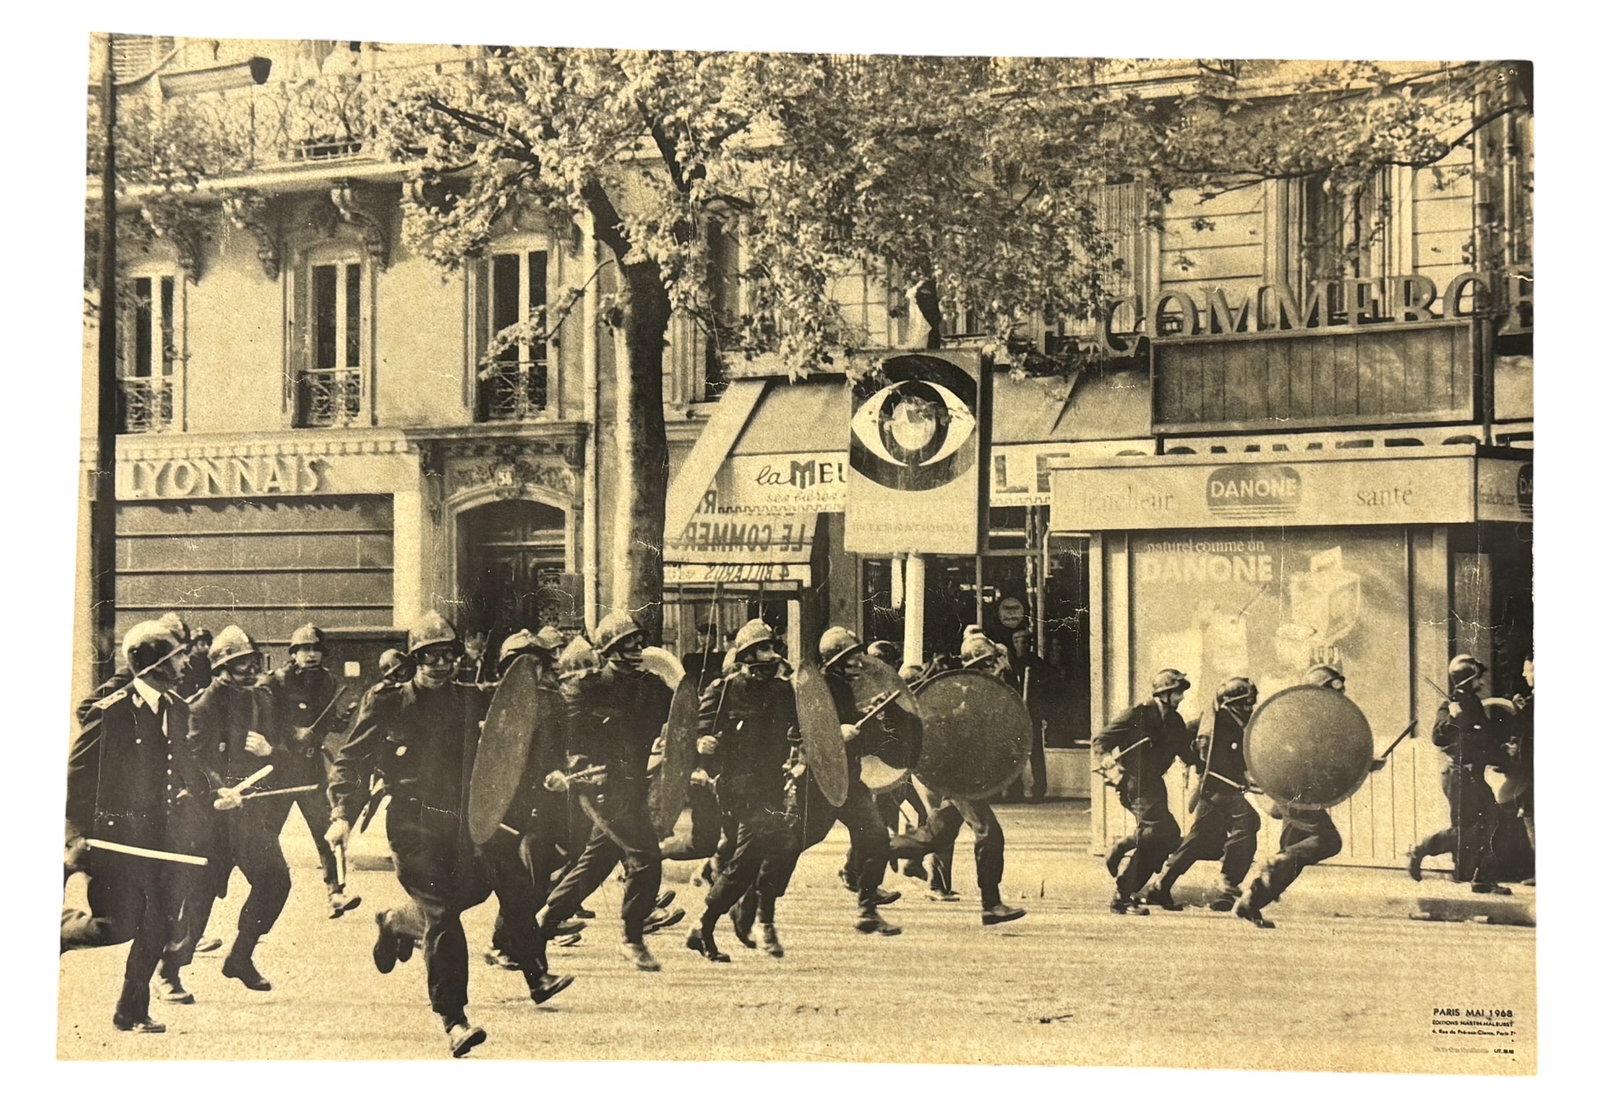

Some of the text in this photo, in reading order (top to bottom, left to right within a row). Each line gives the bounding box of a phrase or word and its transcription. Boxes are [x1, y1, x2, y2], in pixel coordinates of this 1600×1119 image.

[128, 456, 328, 498] LYONNAIS
[1210, 478, 1298, 499] DANONE
[1356, 481, 1414, 506] santé
[1195, 541, 1246, 553] comme
[1248, 540, 1265, 553] un
[1141, 554, 1273, 582] DANONE
[1433, 1008, 1514, 1018] PARIS MAI 1968
